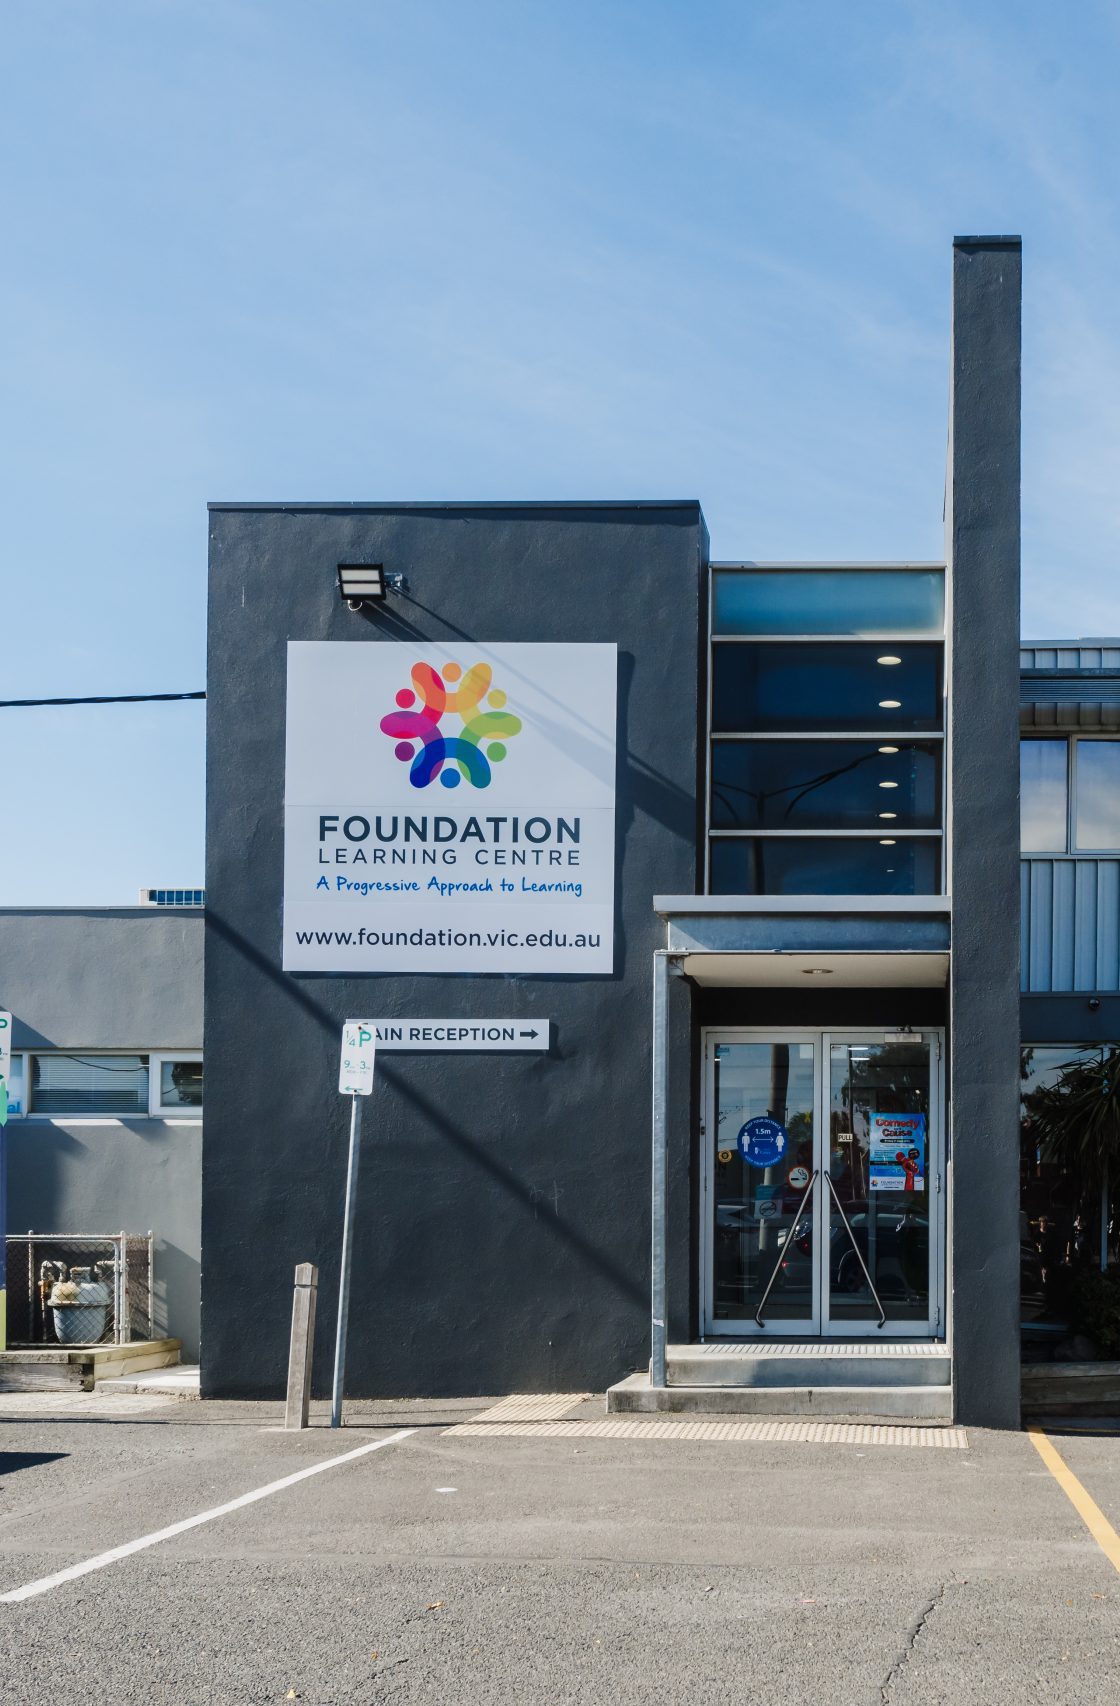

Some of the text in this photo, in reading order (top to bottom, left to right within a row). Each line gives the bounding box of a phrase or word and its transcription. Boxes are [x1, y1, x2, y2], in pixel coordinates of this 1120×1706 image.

[319, 815, 581, 844] FOUNDATION
[318, 848, 580, 866] LEARNING CENTRE
[316, 875, 582, 897] A Progressive Approach to Learning
[295, 928, 601, 948] www.foundation.vic.edu.au
[359, 1031, 372, 1048] P
[375, 1027, 515, 1041] AIN RECEPTION
